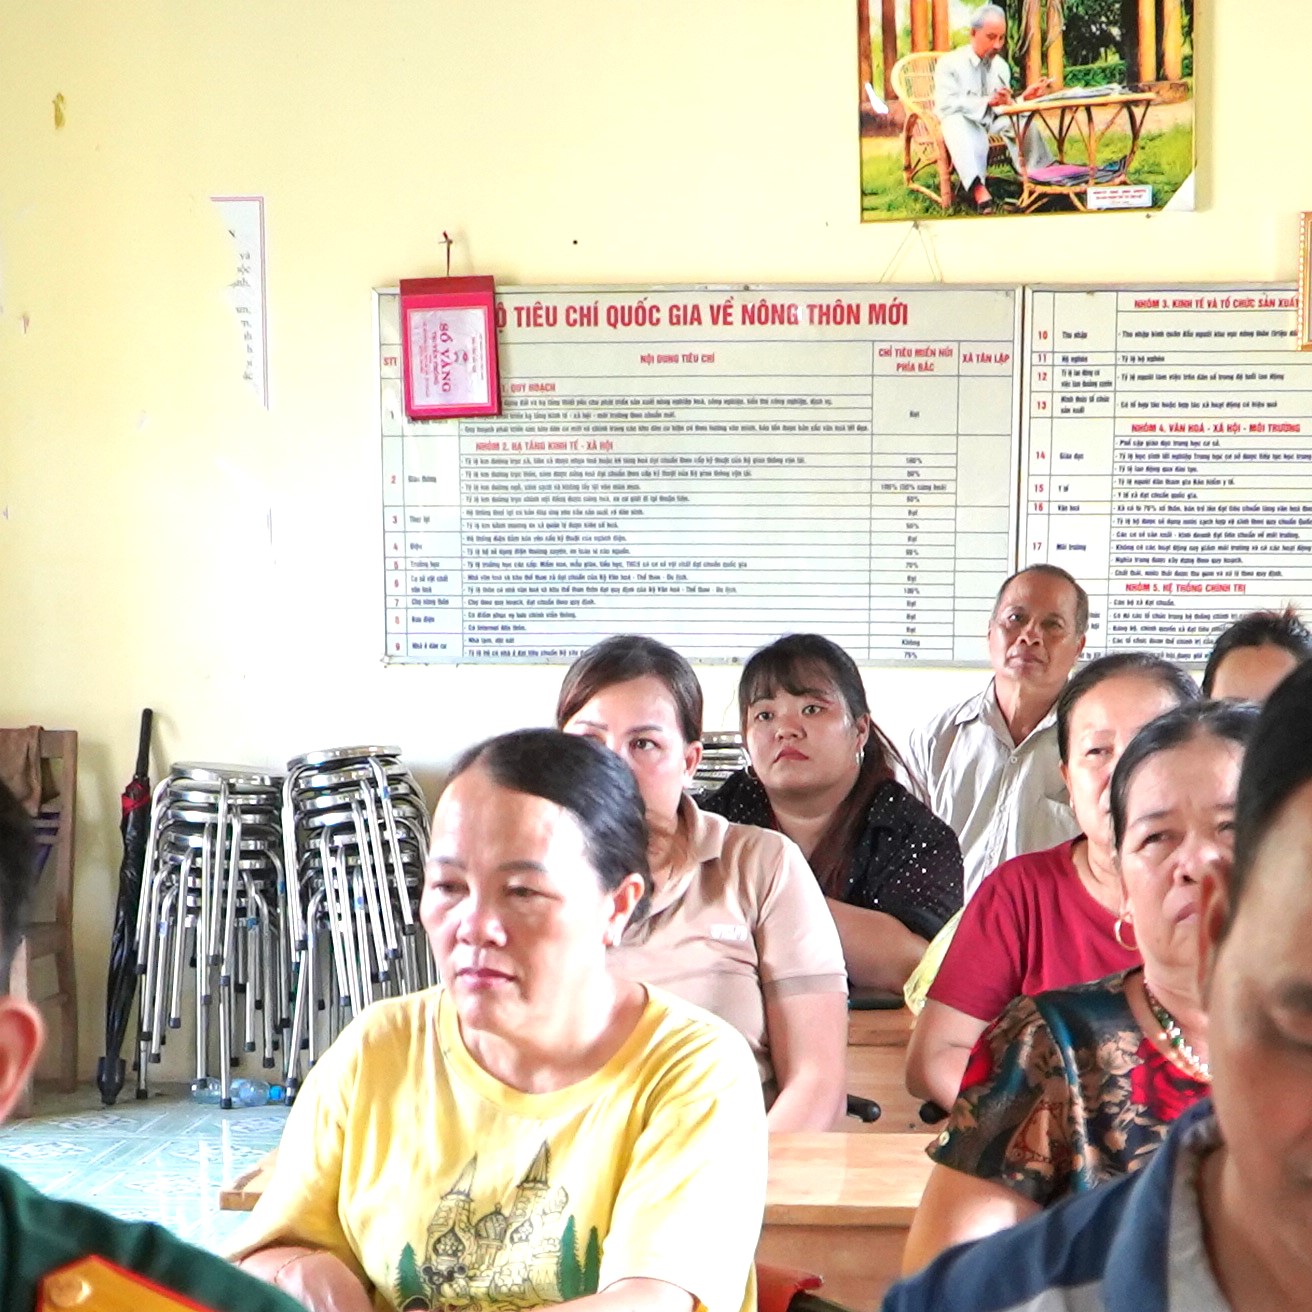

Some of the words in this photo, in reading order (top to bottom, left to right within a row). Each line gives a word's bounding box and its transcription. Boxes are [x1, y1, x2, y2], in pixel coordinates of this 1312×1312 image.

[516, 301, 558, 328] TIÊU
[565, 300, 599, 327] CHÍ
[606, 297, 660, 329] QUỐC
[669, 304, 702, 326] GIA
[710, 297, 733, 326] VỀ
[741, 299, 798, 325] NÔNG
[808, 299, 861, 325] THÔN
[868, 297, 908, 325] MỚI
[1039, 331, 1048, 340] 10
[1038, 353, 1046, 363] 11
[1038, 372, 1047, 381] 12
[1037, 401, 1046, 410] 13
[1036, 451, 1045, 459] 14
[1035, 484, 1044, 492] 15
[1033, 542, 1041, 550] 17
